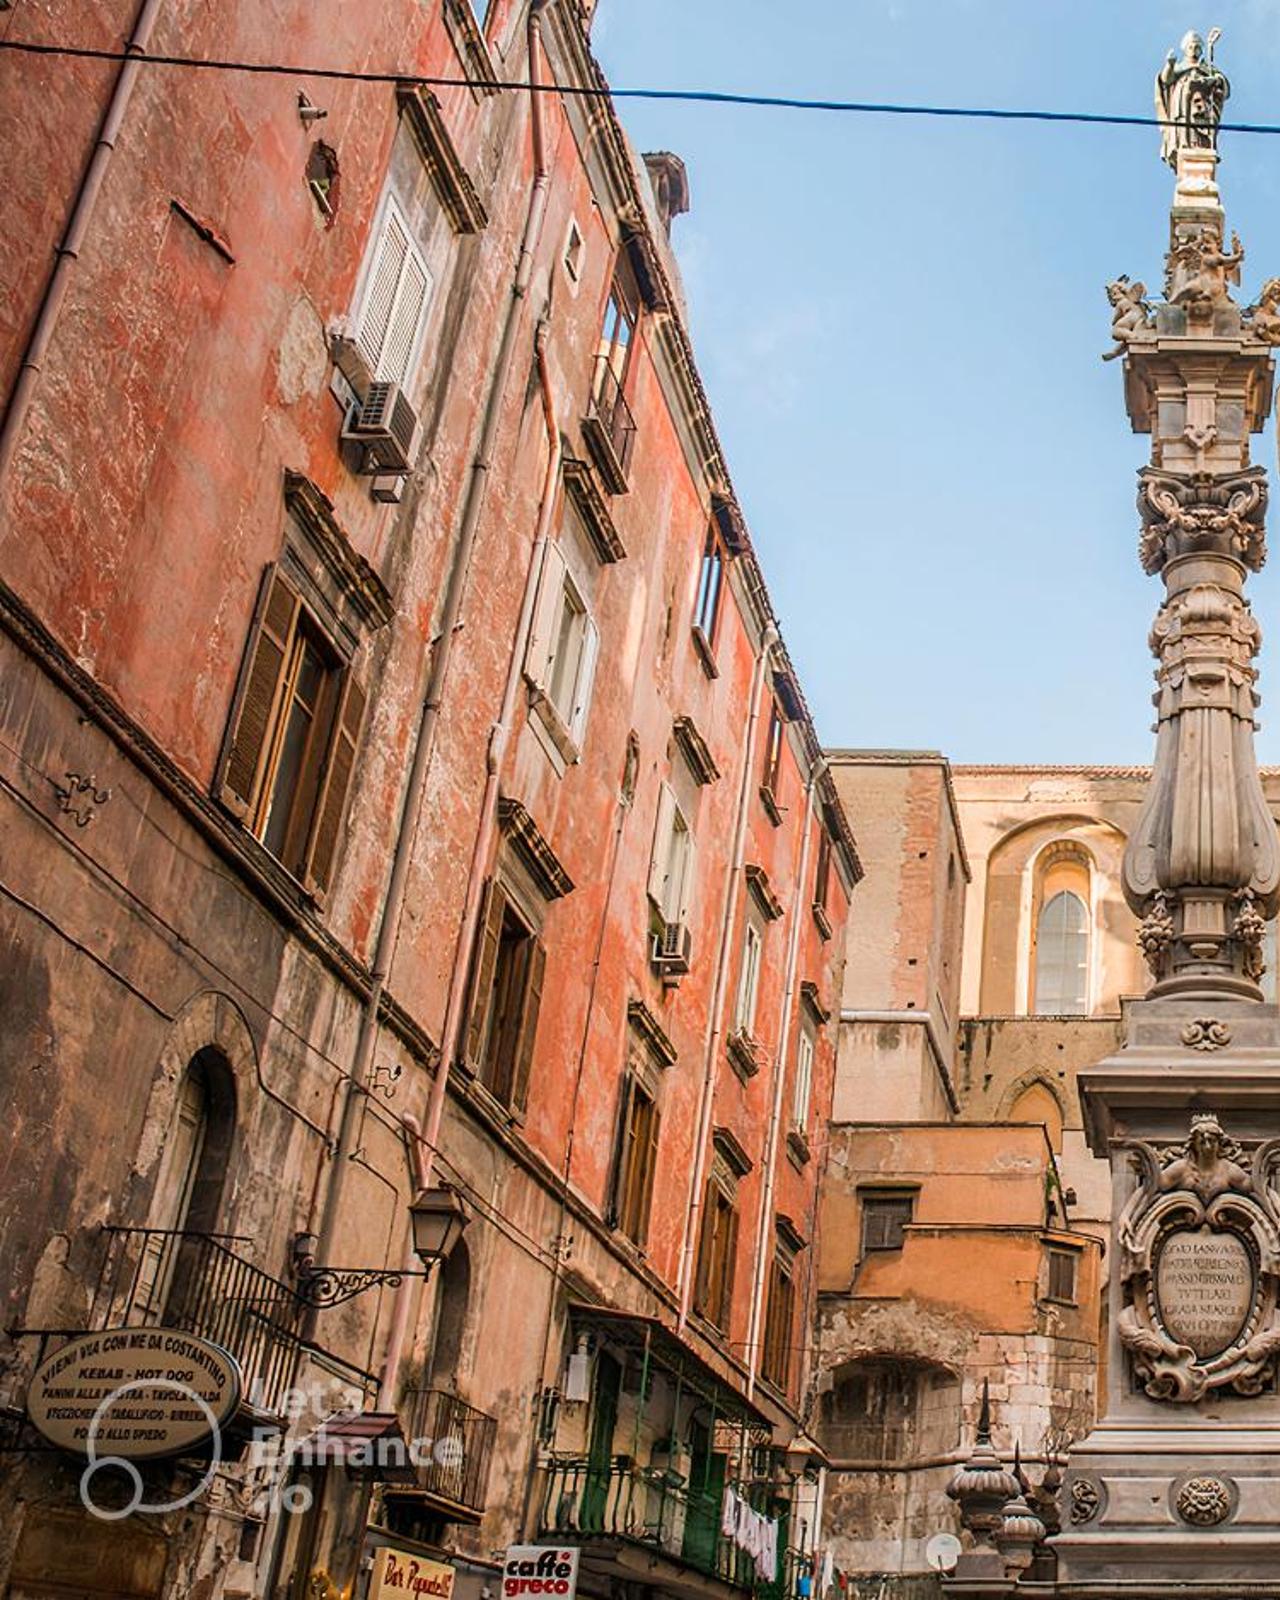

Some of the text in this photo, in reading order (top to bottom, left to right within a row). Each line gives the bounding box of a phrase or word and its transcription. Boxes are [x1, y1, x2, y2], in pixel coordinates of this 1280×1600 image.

[102, 1335, 128, 1353] CON
[130, 1334, 146, 1349] ME
[165, 1337, 226, 1389] COSTANTINO
[78, 1368, 123, 1380] KEBAB
[134, 1369, 163, 1380] HOT
[166, 1370, 194, 1382] DOG
[504, 1578, 569, 1597] greco
